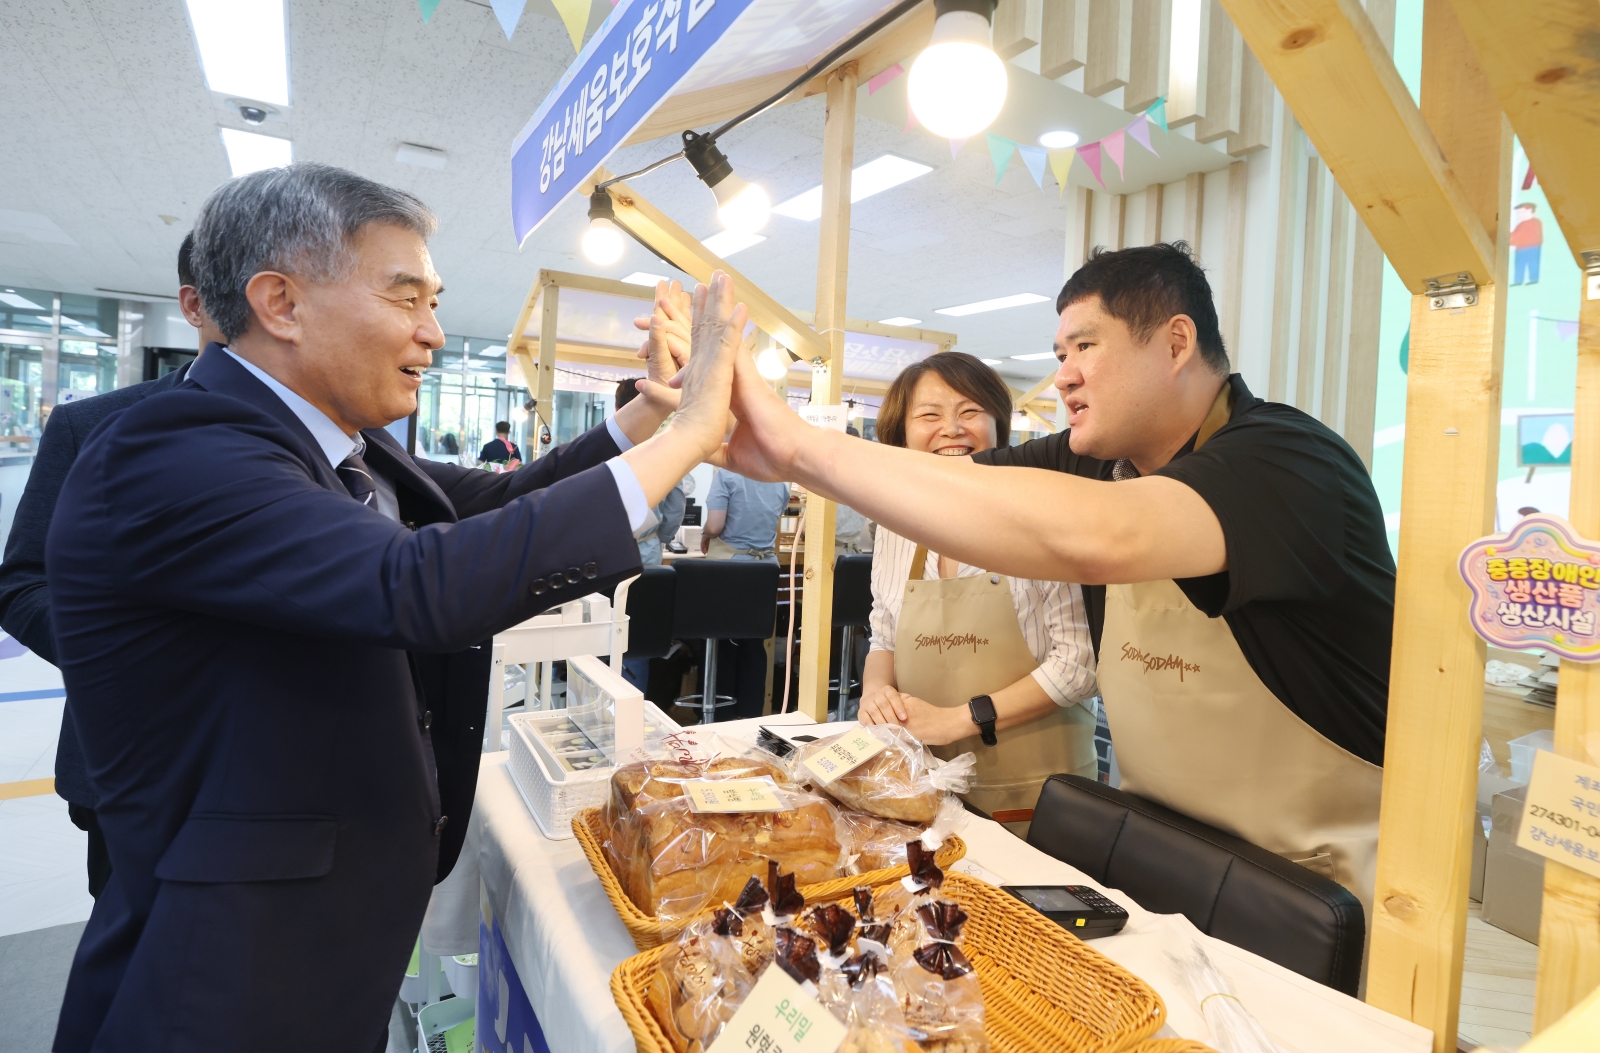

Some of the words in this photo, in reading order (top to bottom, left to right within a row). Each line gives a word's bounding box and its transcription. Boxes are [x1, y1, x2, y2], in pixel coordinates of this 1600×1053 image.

[1486, 557, 1600, 590] 중증장애인
[1504, 580, 1584, 609] 생산품
[1496, 601, 1595, 635] 생산시설
[1143, 652, 1184, 682] SODAM
[852, 736, 871, 751] 우리밀
[816, 756, 839, 774] 5,000원
[774, 998, 813, 1043] 우리밀
